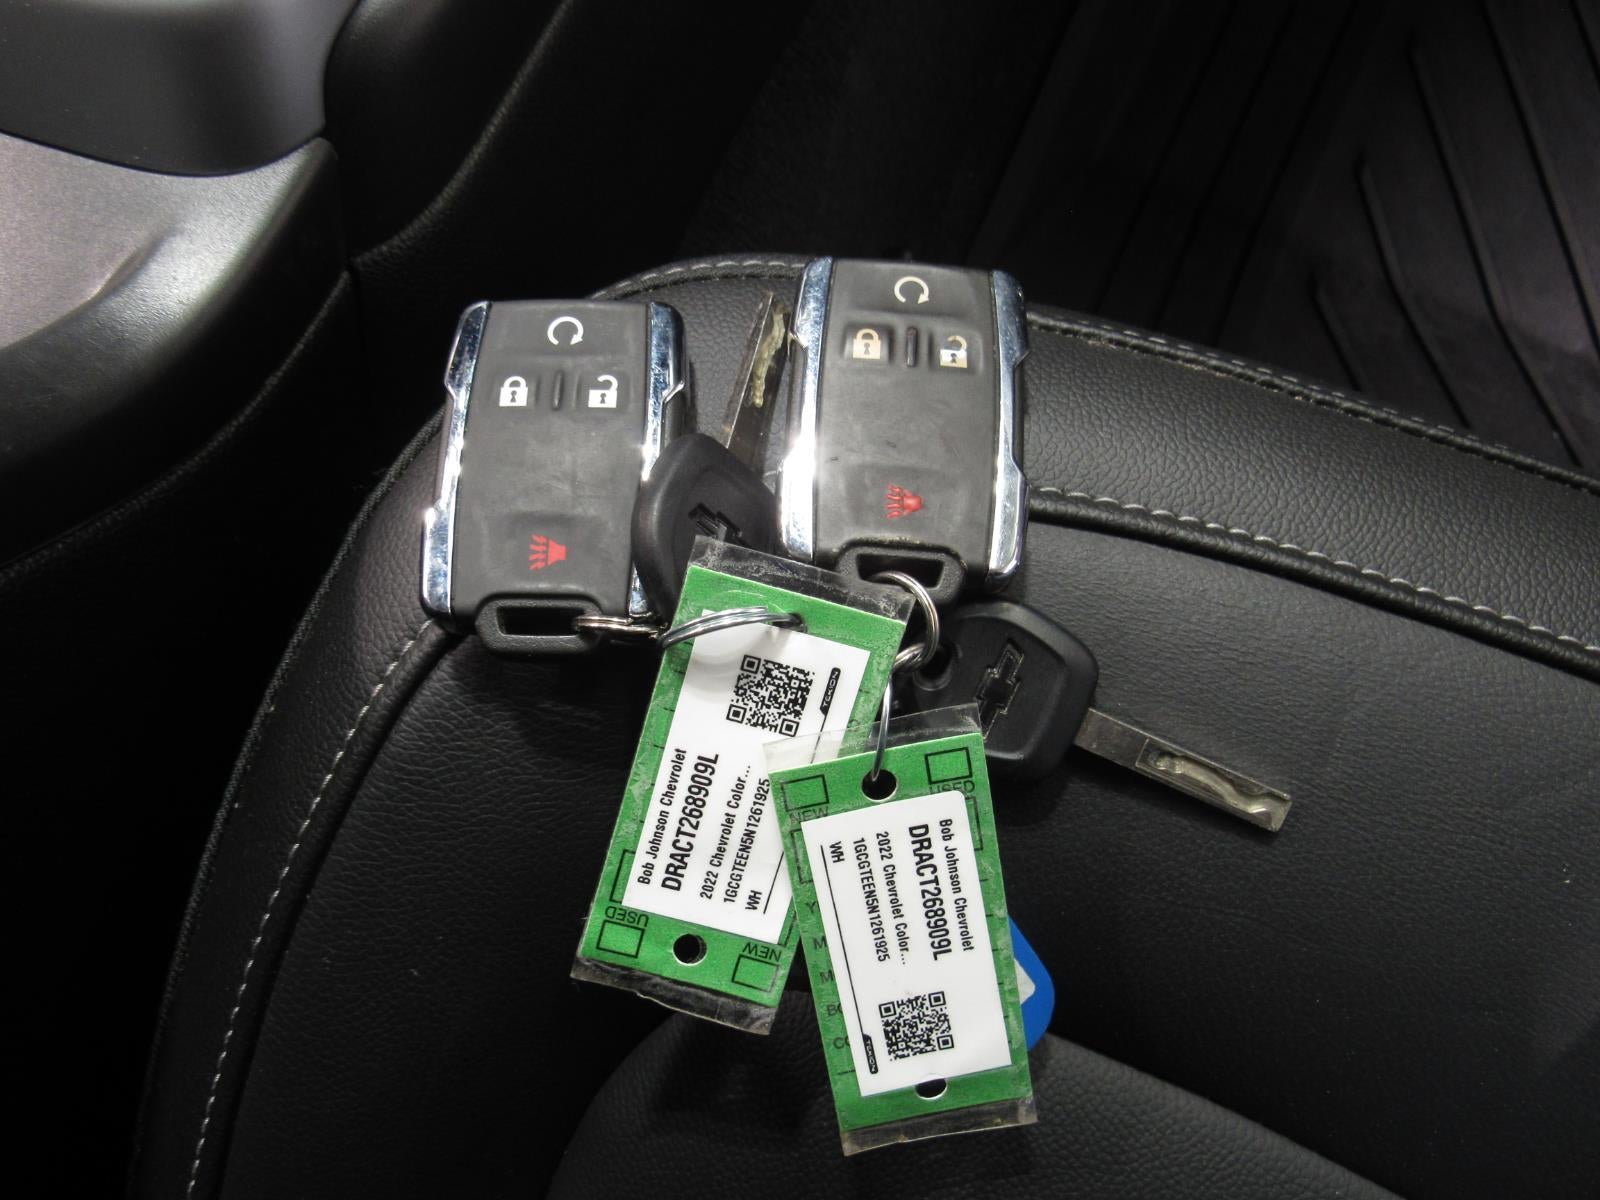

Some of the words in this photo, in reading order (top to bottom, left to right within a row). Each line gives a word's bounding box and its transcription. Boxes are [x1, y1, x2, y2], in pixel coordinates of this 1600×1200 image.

[822, 670, 839, 708] TEKION
[637, 862, 655, 885] Bob
[646, 810, 669, 860] Johnson
[660, 748, 687, 806] Chevrolet
[661, 753, 719, 891] DRACT268909L
[709, 812, 736, 868] Chevrolet
[723, 778, 770, 903] 1GCGTEEN5N1261925
[939, 818, 954, 842] Bob
[829, 841, 845, 863] WH
[876, 831, 894, 860] 2022
[944, 845, 962, 894] Johnson
[700, 870, 719, 899] 2022
[745, 889, 762, 911] WH
[853, 837, 890, 962] 1GCGTEEN5N1261925
[883, 864, 903, 919] Chevrolet
[908, 824, 952, 961] DRACT268909L
[604, 905, 649, 927] USED
[954, 897, 975, 951] Chevrolet
[742, 942, 782, 962] NEW
